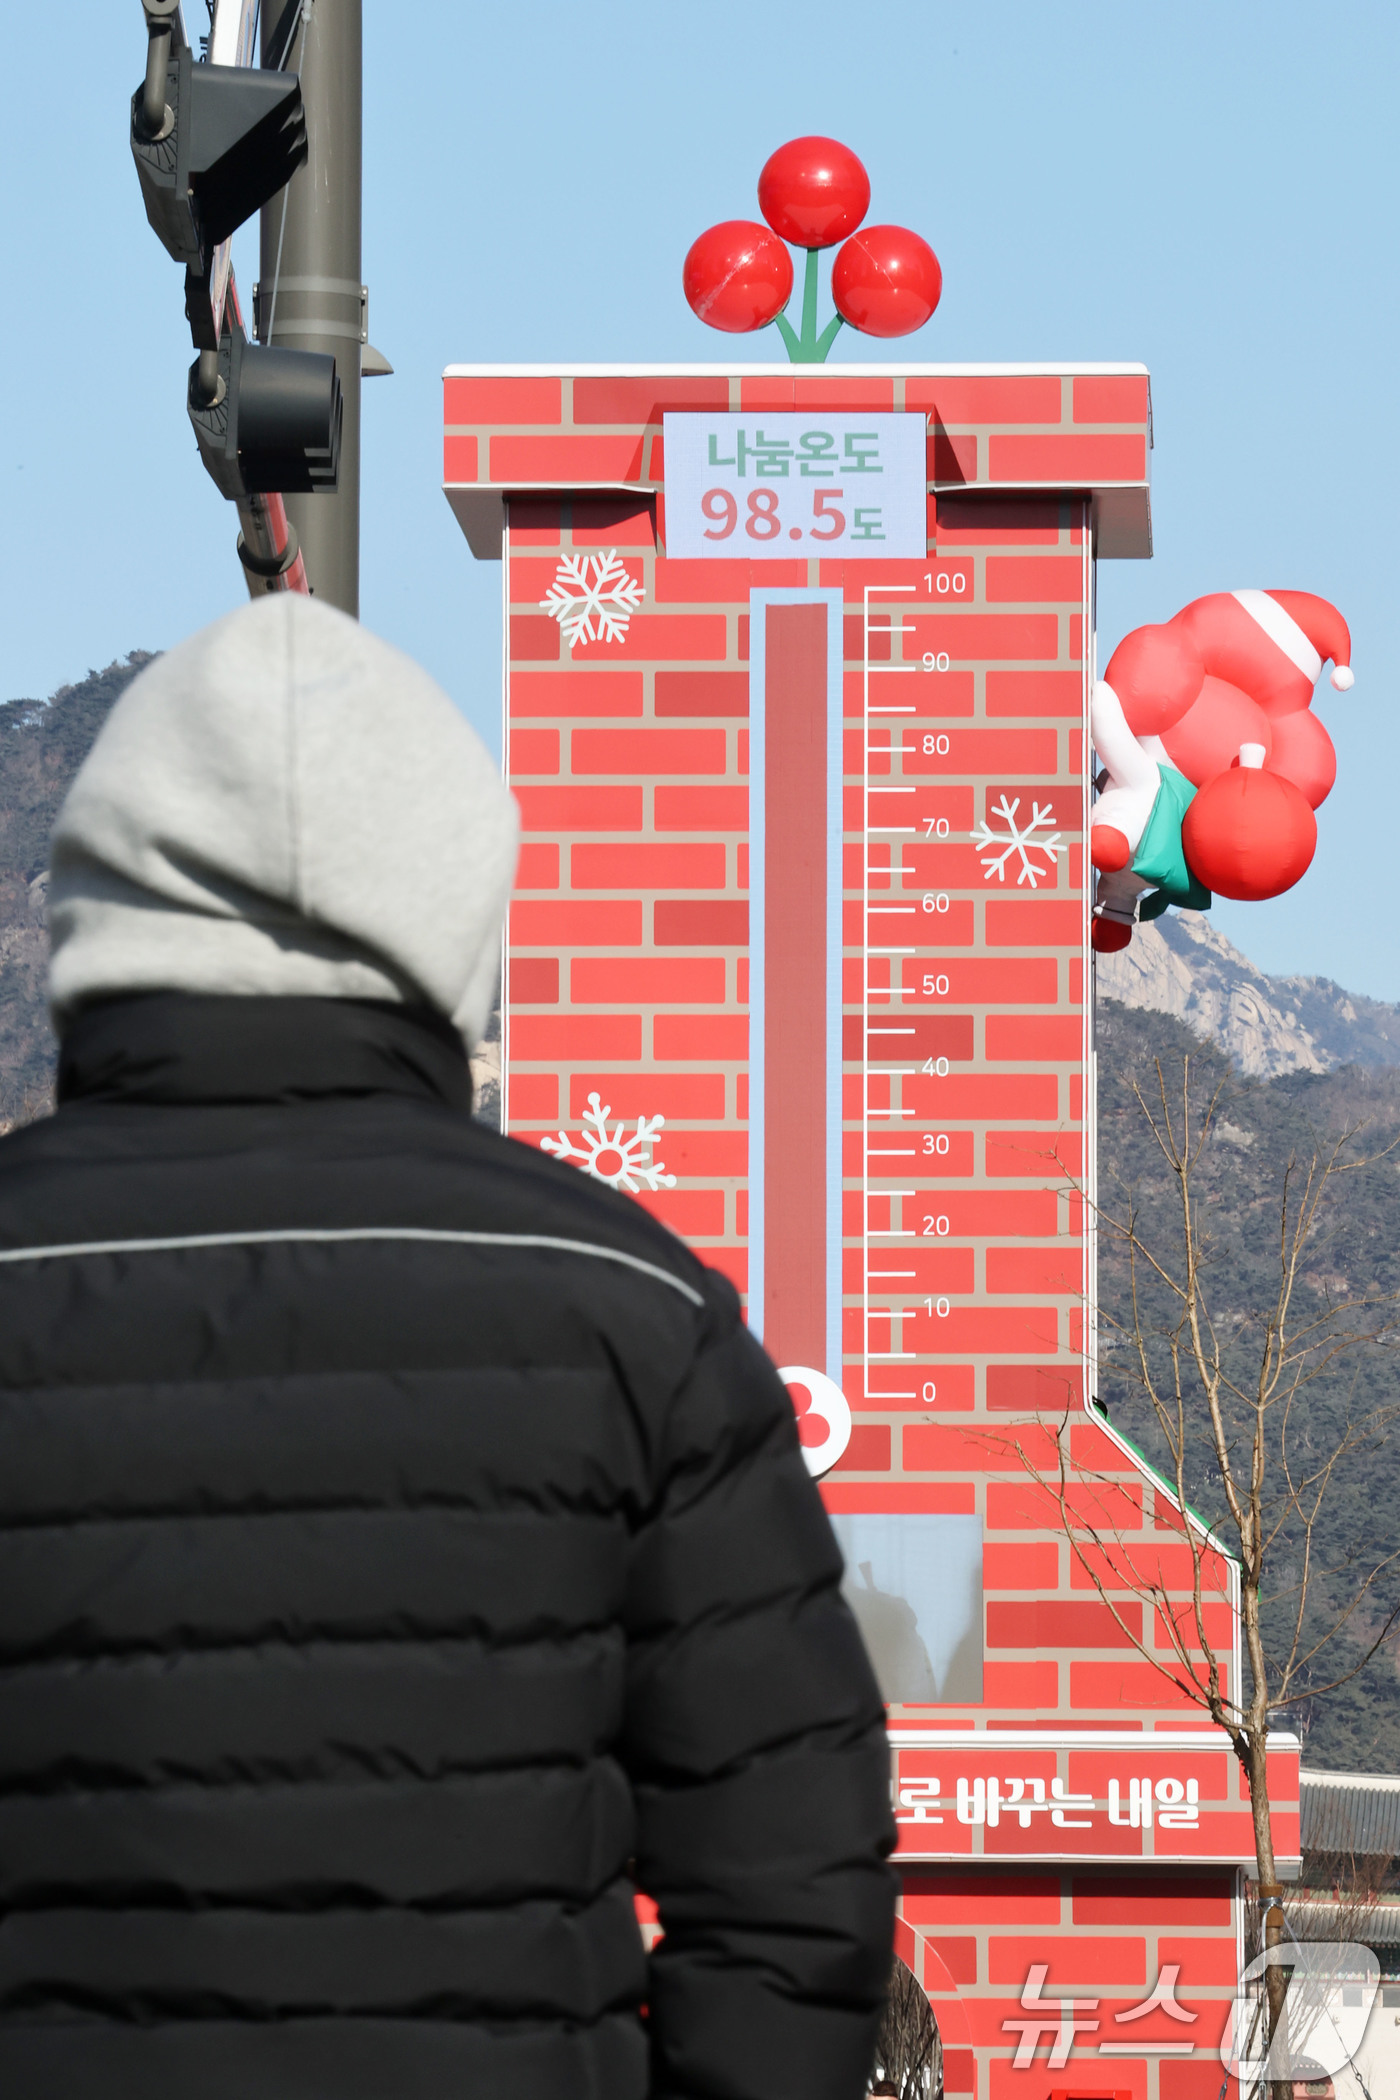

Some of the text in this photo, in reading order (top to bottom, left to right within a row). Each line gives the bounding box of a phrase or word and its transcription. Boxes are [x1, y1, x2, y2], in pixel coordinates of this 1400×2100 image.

[708, 429, 884, 478] 나눔온도
[924, 573, 966, 594] 100
[922, 652, 950, 673] 90
[922, 734, 951, 755] 80
[922, 818, 950, 838] 70
[922, 893, 950, 914] 60
[922, 974, 950, 996] 50
[922, 1056, 950, 1077] 40
[922, 1134, 950, 1155] 30
[922, 1215, 950, 1236] 20
[923, 1297, 950, 1318] 10
[922, 1382, 937, 1403] 0
[888, 1776, 1200, 1829] 로 바꾸는 내일
